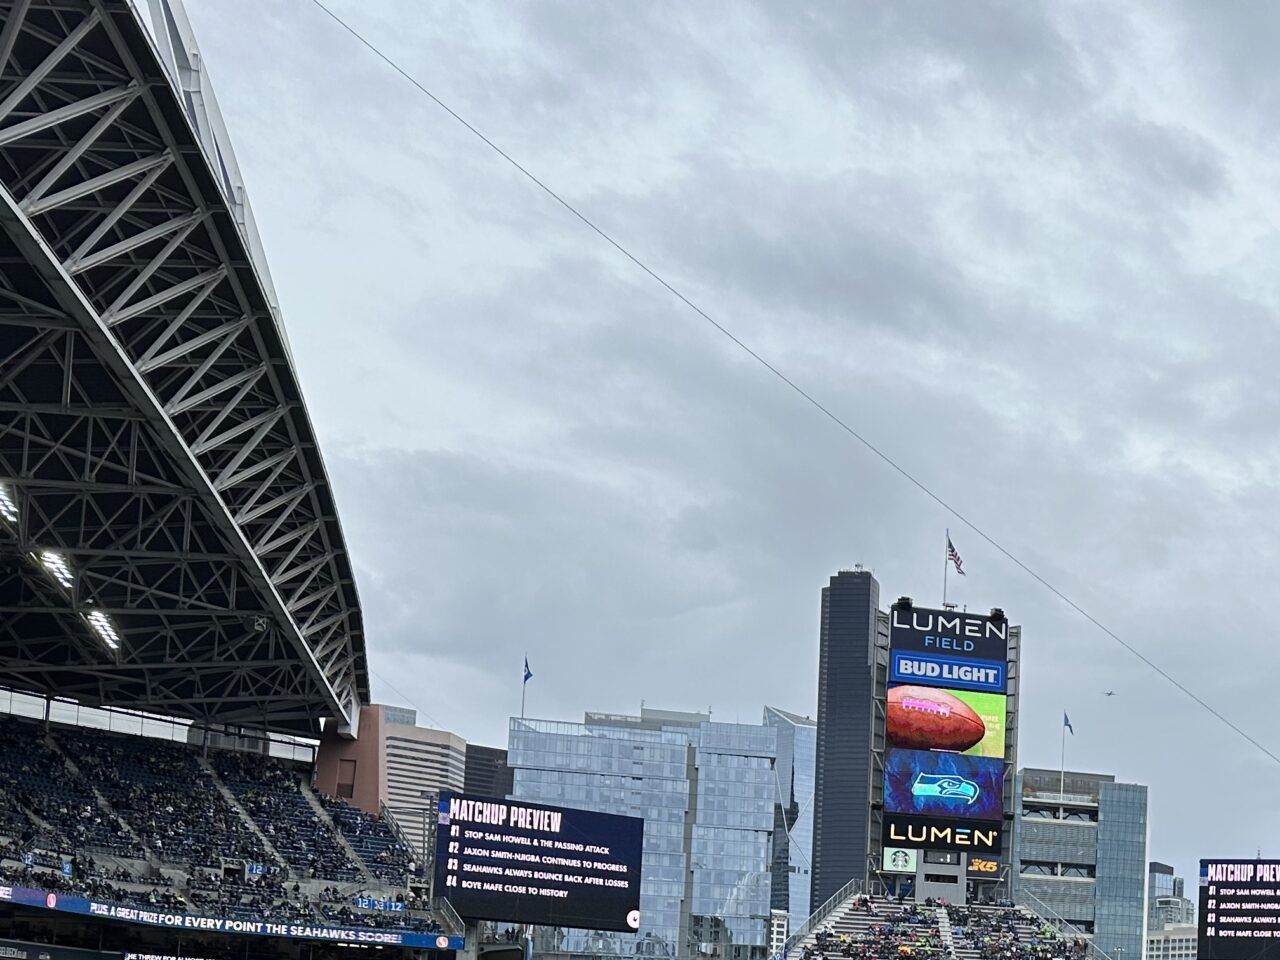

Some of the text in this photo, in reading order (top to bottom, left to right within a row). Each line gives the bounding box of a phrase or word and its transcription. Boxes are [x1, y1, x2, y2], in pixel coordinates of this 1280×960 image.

[893, 610, 1006, 640] LUMEN
[924, 636, 974, 652] FIELD
[900, 660, 998, 683] BUD LIGHT
[450, 798, 562, 832] MATCHUP PREVIEW
[464, 830, 482, 840] STOP
[485, 832, 500, 842] SAM
[503, 835, 531, 845] HOWELL
[540, 840, 552, 848] THE
[554, 842, 584, 852] PASSING
[585, 846, 610, 854] ATTACK
[890, 824, 994, 846] LUMEN
[464, 847, 489, 856] JAXON
[542, 856, 581, 867] CONTINUES
[594, 862, 628, 872] PROGRESS
[463, 864, 628, 888] SEAHAWKS ALWAYS BOUNCE BACK AFTER LOSSES
[1208, 864, 1254, 882] MATCHUP
[462, 880, 482, 889] BOYE
[483, 883, 502, 891] MAFE
[504, 884, 526, 894] CLOSE
[540, 888, 568, 898] HISTORY
[110, 906, 402, 944] A GREAT PRIZE FOR EVERY POINT THE SEAHAWKS SCORE!
